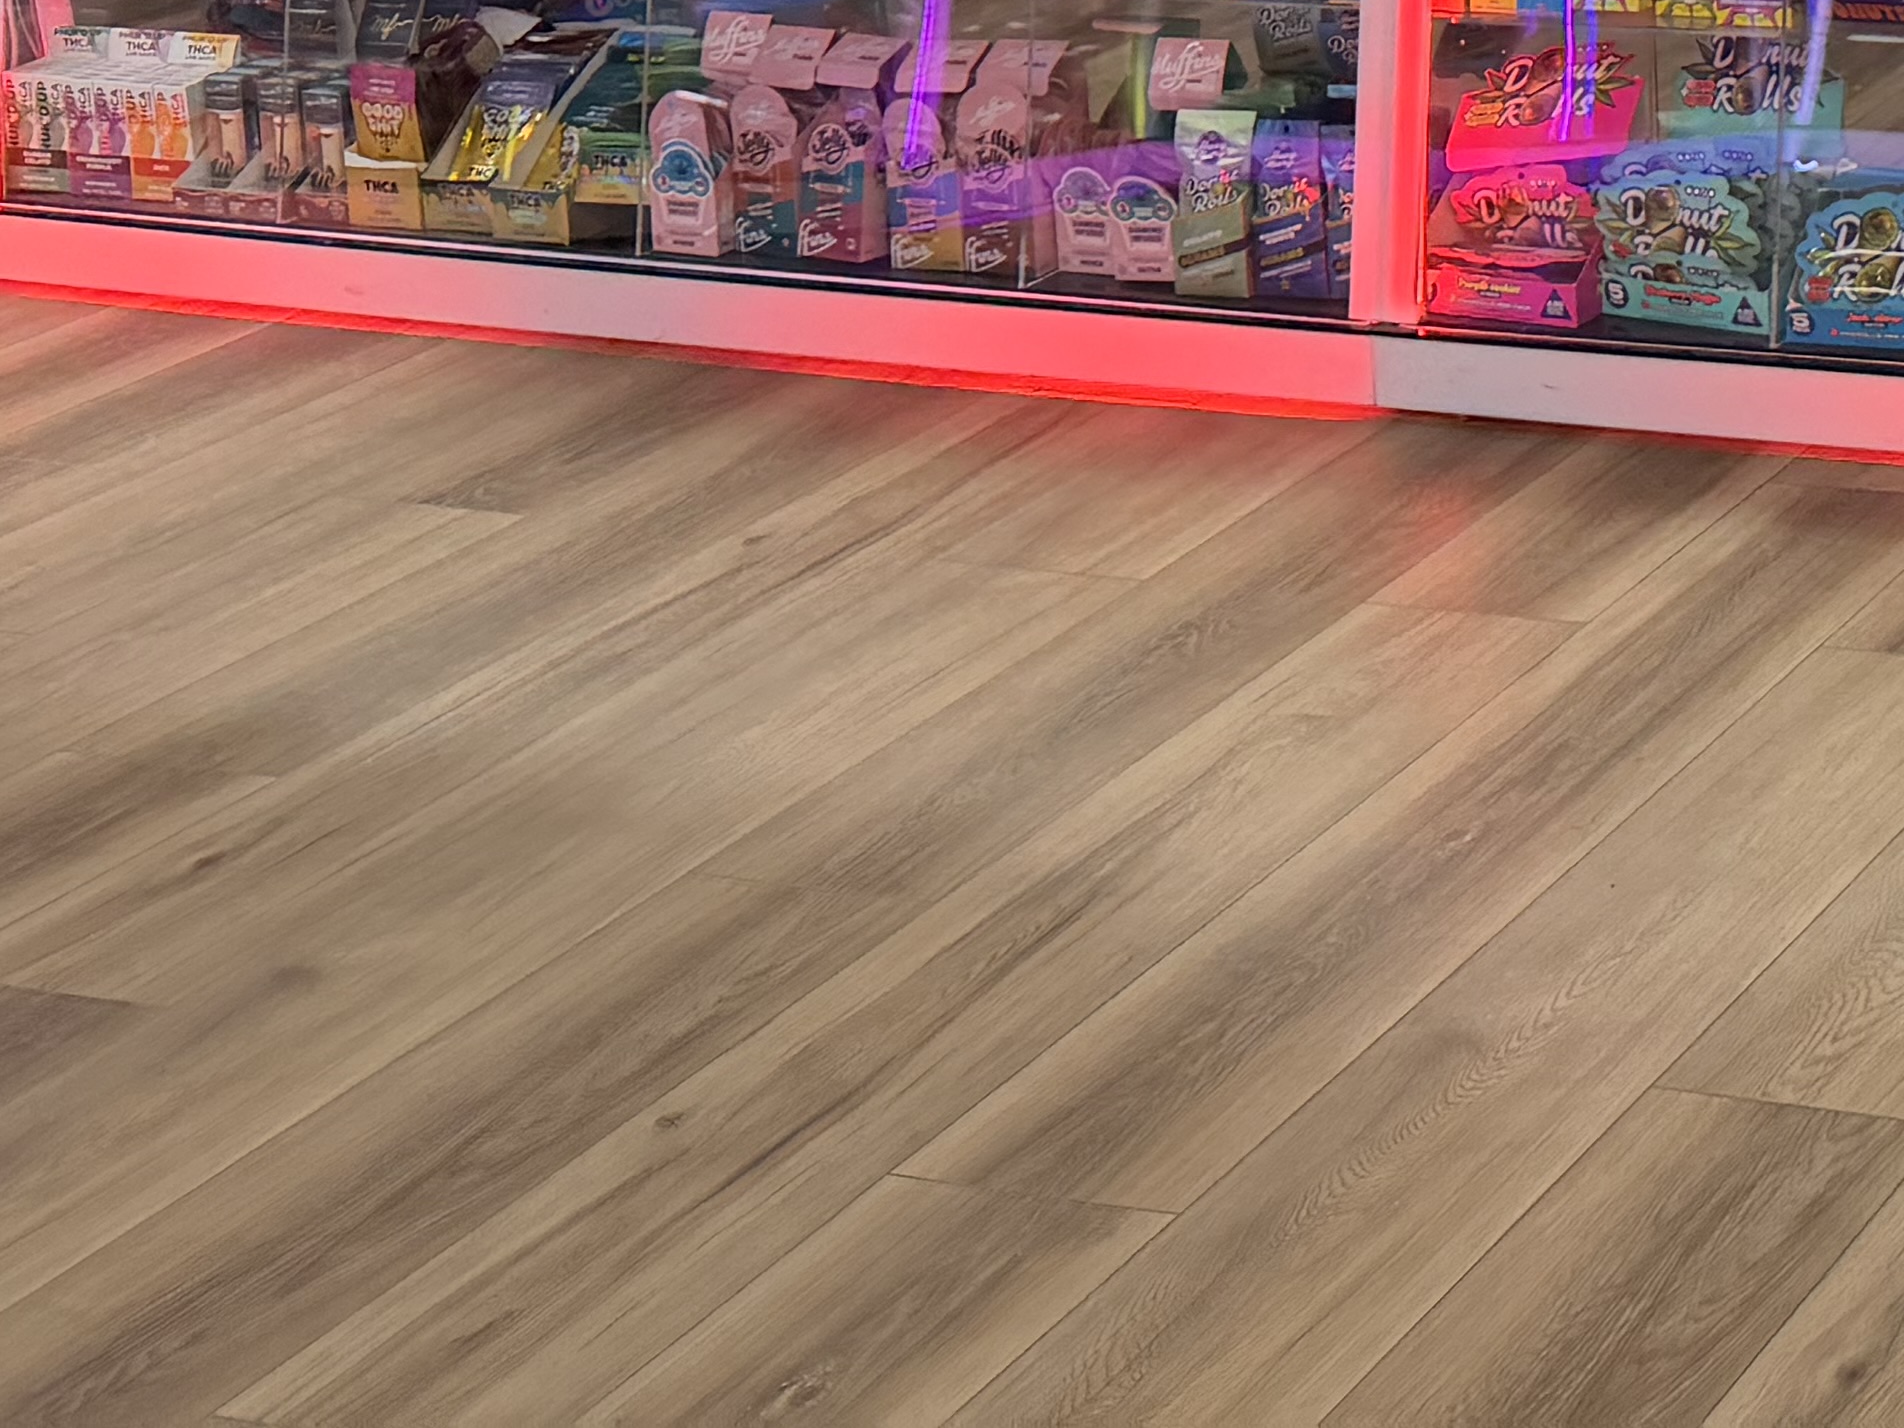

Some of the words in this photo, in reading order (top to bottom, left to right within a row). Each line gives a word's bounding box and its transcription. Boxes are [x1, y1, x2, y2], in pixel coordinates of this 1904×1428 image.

[62, 37, 94, 50] THCA
[126, 38, 157, 53] THCA
[365, 180, 399, 194] THCA
